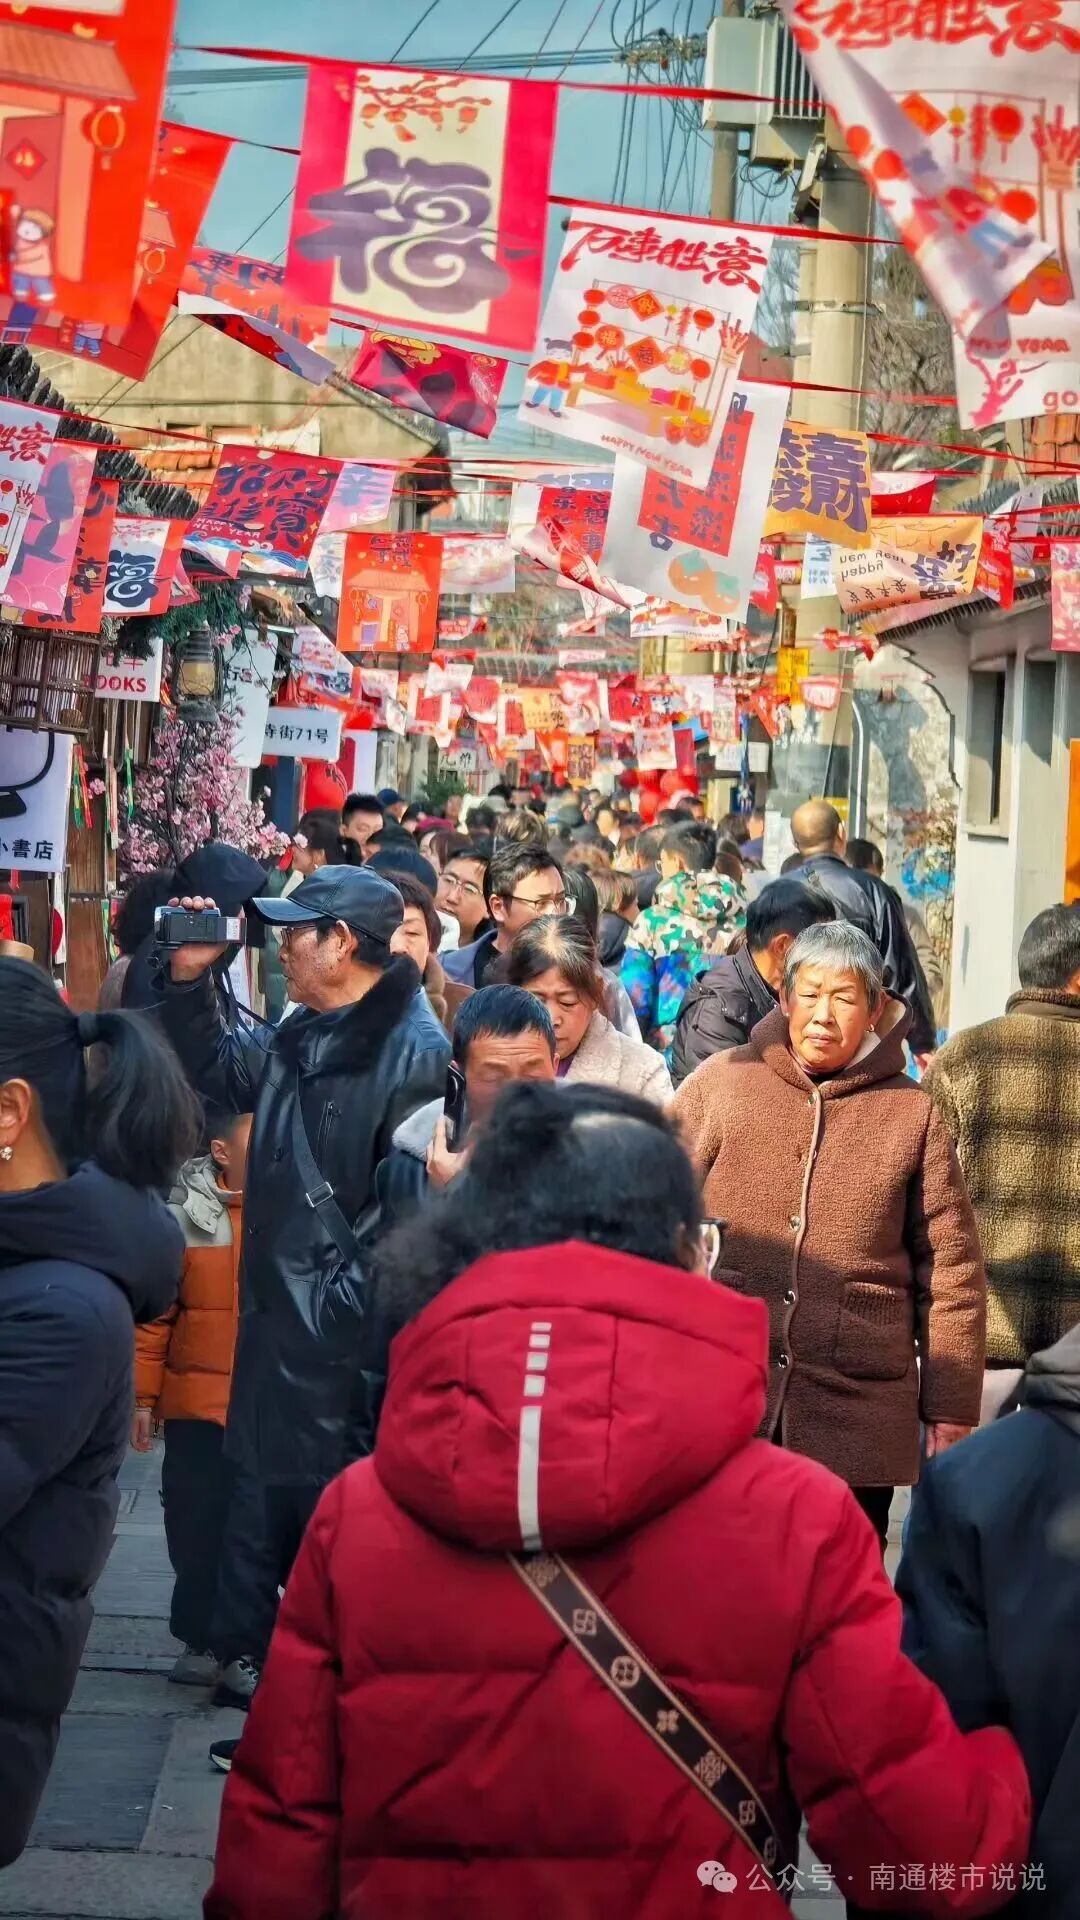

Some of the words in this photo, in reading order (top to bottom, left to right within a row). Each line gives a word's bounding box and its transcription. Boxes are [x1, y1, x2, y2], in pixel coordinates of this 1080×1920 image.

[601, 434, 635, 453] HAPPY
[636, 446, 662, 465] NEW
[663, 454, 694, 479] YEAR
